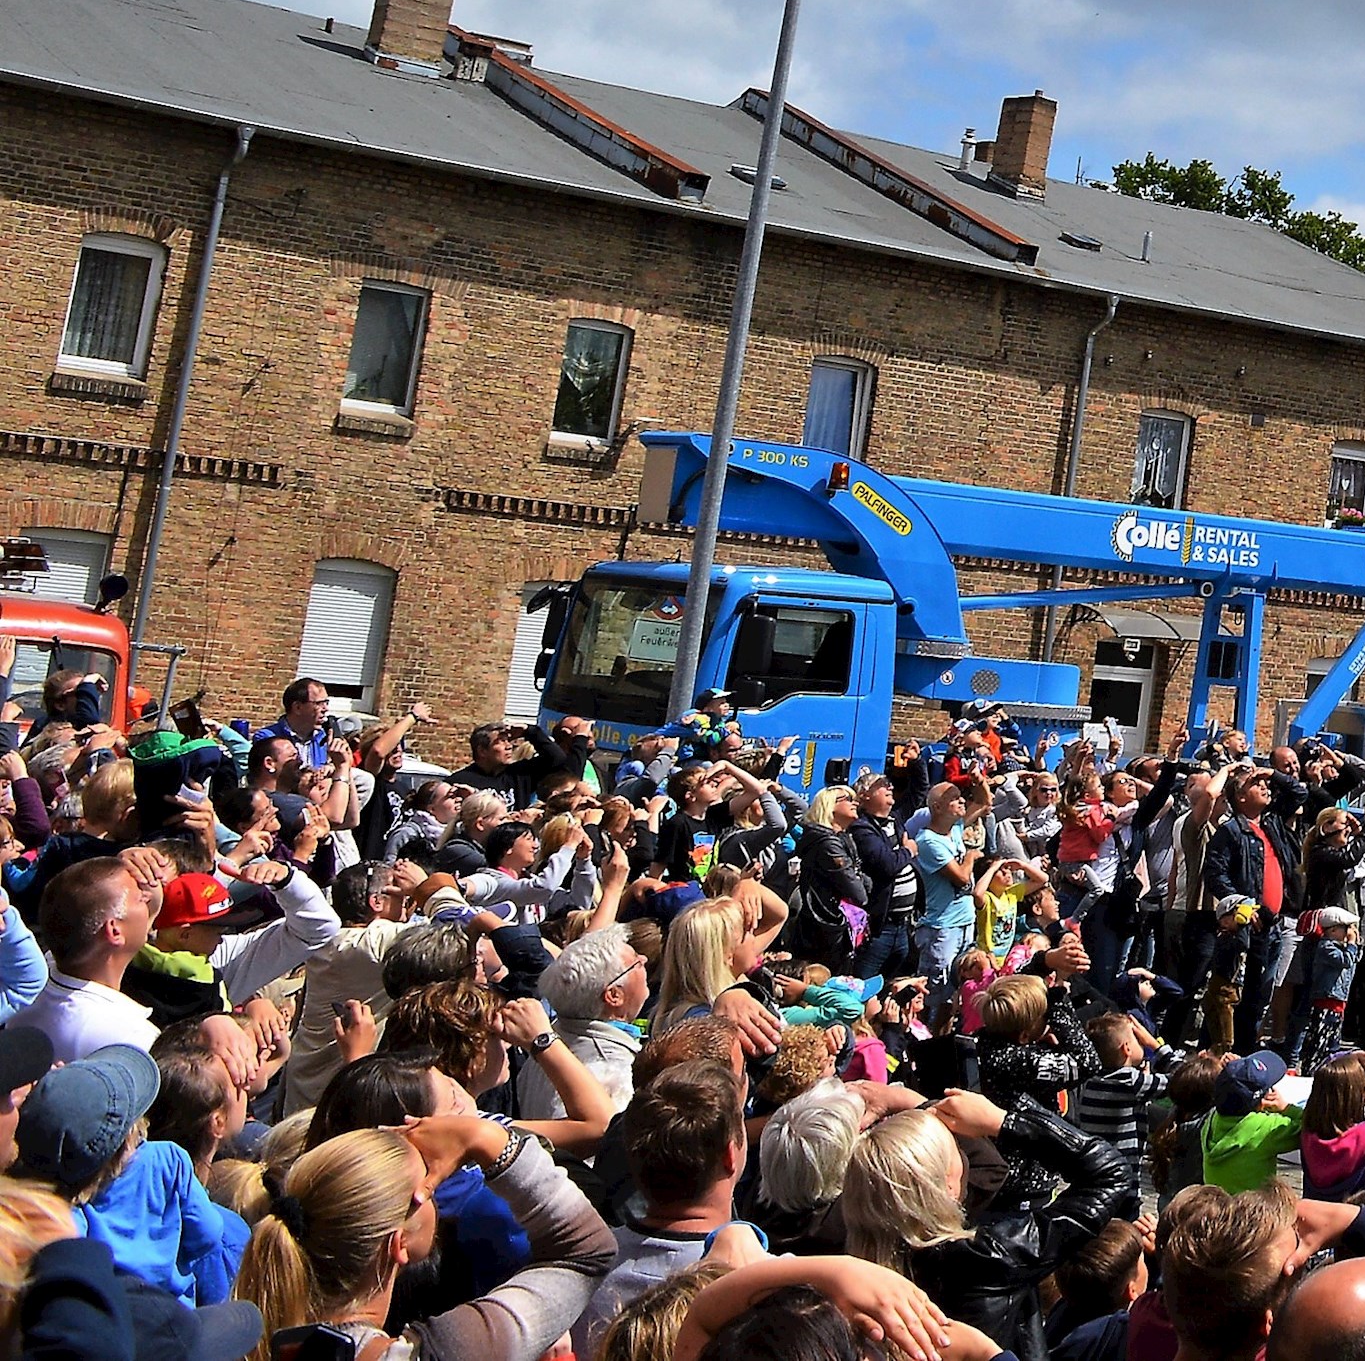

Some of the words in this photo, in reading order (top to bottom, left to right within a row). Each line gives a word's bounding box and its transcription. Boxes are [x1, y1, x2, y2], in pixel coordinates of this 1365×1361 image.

[743, 448, 753, 460] P
[757, 450, 786, 465] 300
[790, 455, 810, 468] KS
[854, 485, 908, 532] PALFINGER
[1114, 514, 1181, 556] Collé
[1195, 527, 1261, 549] RENTAL
[1192, 545, 1205, 562] &
[1206, 547, 1259, 568] SALES
[640, 634, 679, 648] Feuerwe
